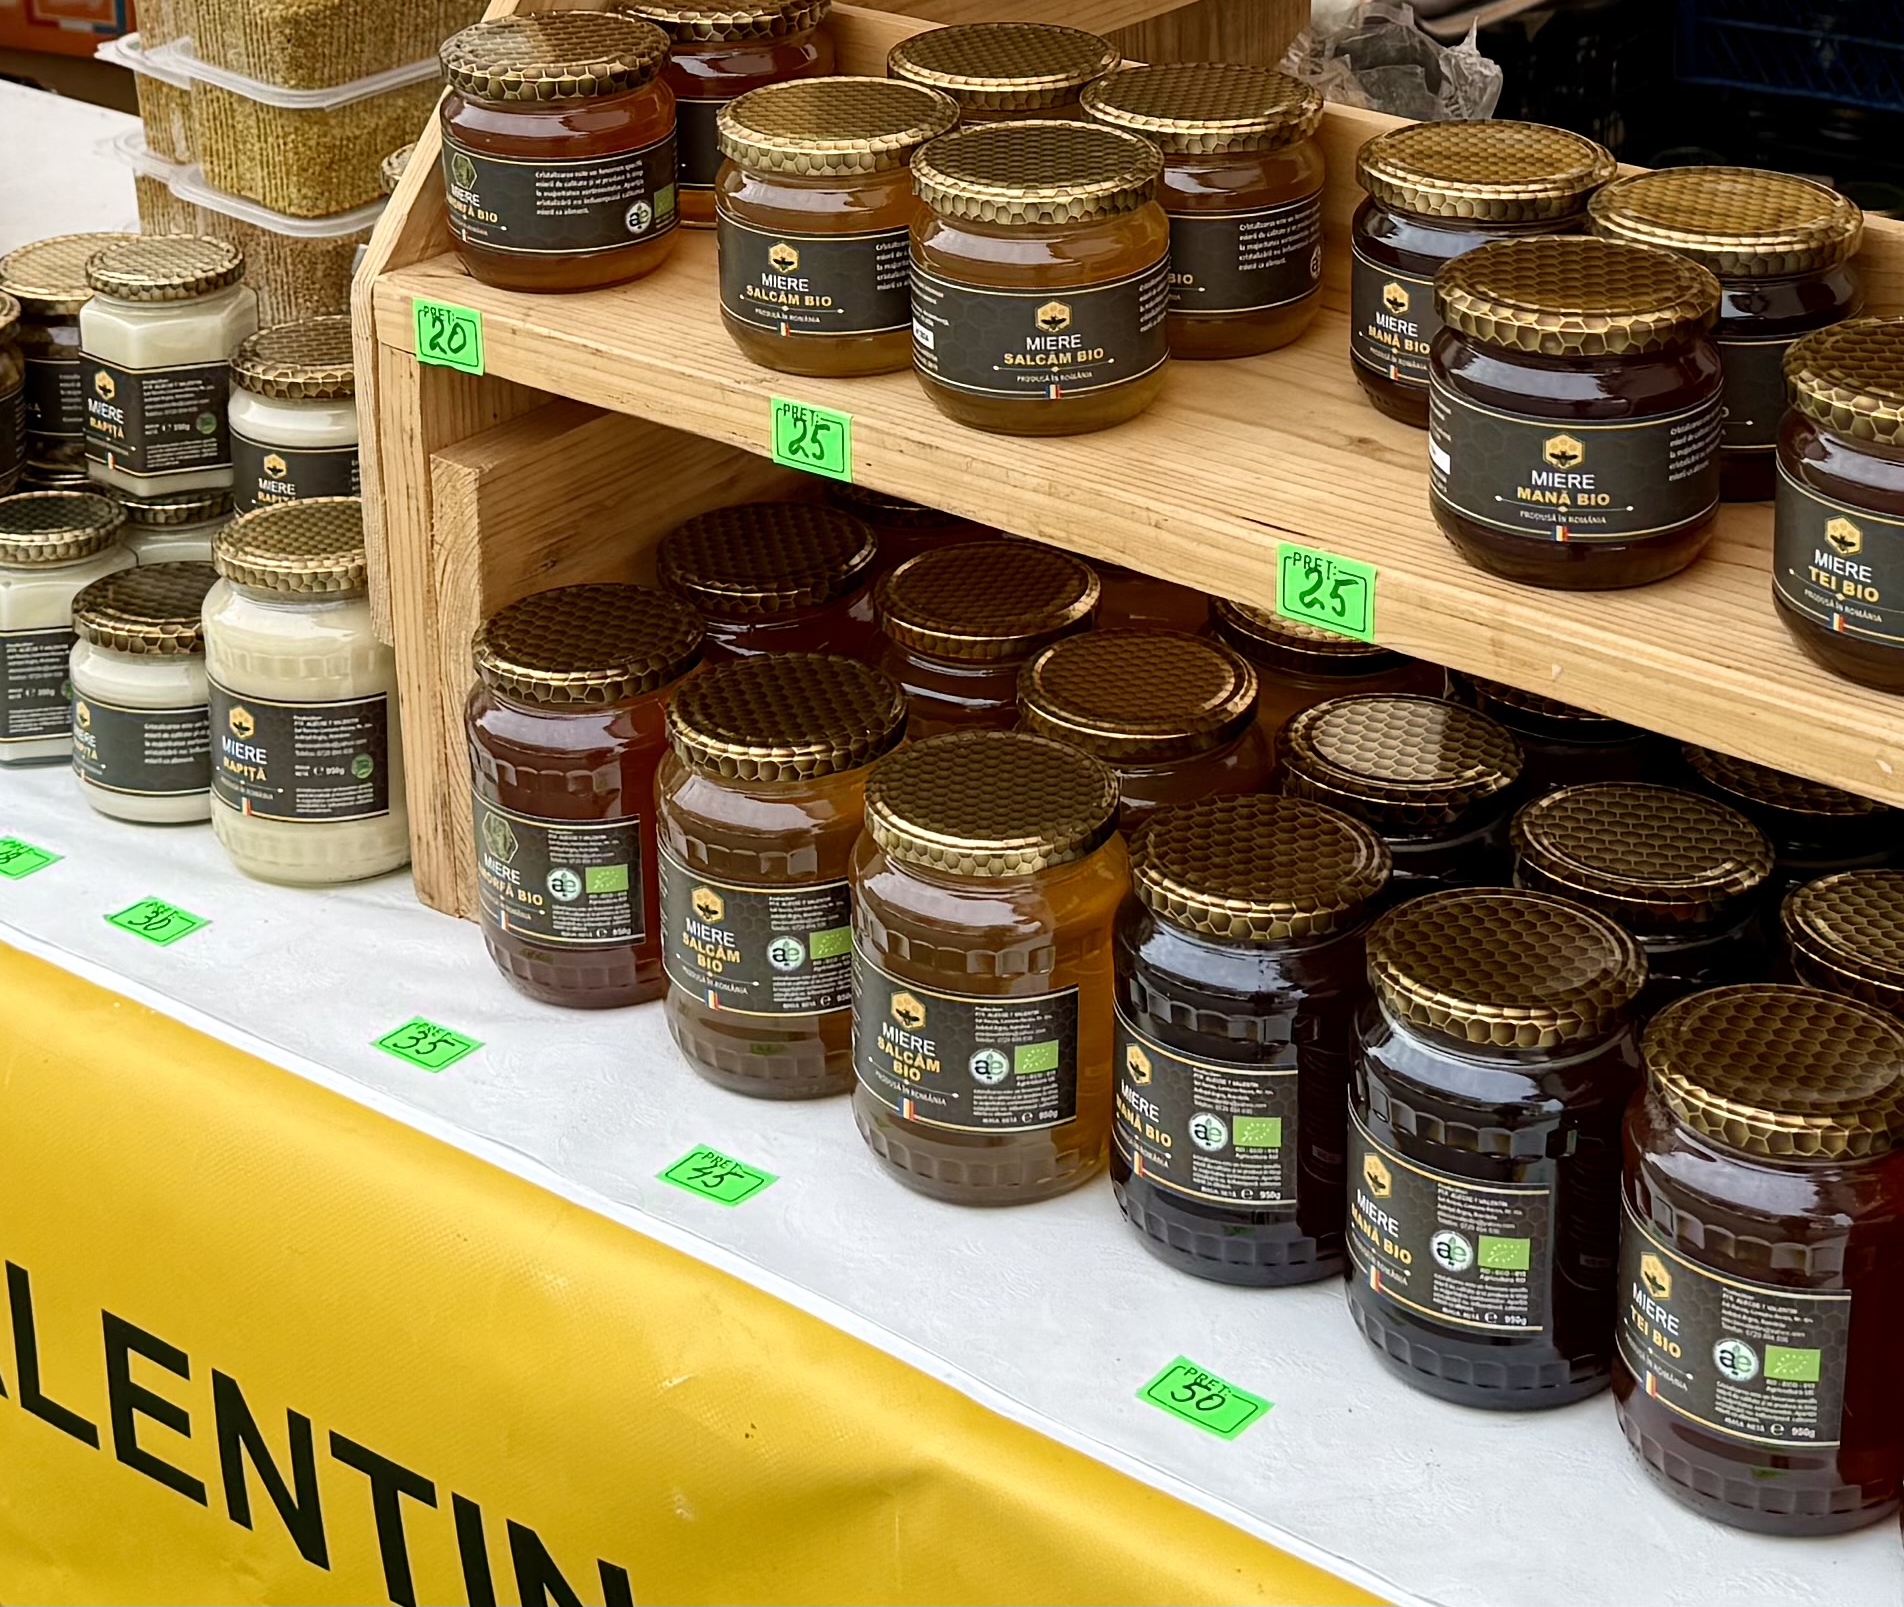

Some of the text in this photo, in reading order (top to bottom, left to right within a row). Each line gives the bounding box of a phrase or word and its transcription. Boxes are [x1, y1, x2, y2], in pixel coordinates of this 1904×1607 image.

[761, 272, 809, 292] MIERE
[805, 294, 832, 308] BIO
[429, 317, 467, 355] 20
[1025, 334, 1082, 351] MIERE
[1076, 347, 1104, 363] BIO
[88, 398, 124, 425] MIERE
[789, 418, 831, 461] 25
[1531, 469, 1596, 490] MIERE
[1517, 486, 1610, 506] MANĂ BIO
[1814, 548, 1872, 582] MIERE
[1299, 572, 1358, 617] 25
[1807, 565, 1880, 603] TEI BIO
[222, 735, 267, 765] MIERE
[130, 911, 172, 934] 30
[686, 917, 736, 947] MIERE
[697, 955, 723, 974] BIO
[394, 1029, 454, 1055] 35
[882, 1022, 936, 1057] MIERE
[893, 1061, 922, 1083] BIO
[687, 1163, 744, 1190] 45
[1357, 1189, 1400, 1237] MIERE
[1383, 1238, 1412, 1265] BIO
[1169, 1379, 1226, 1413] 50
